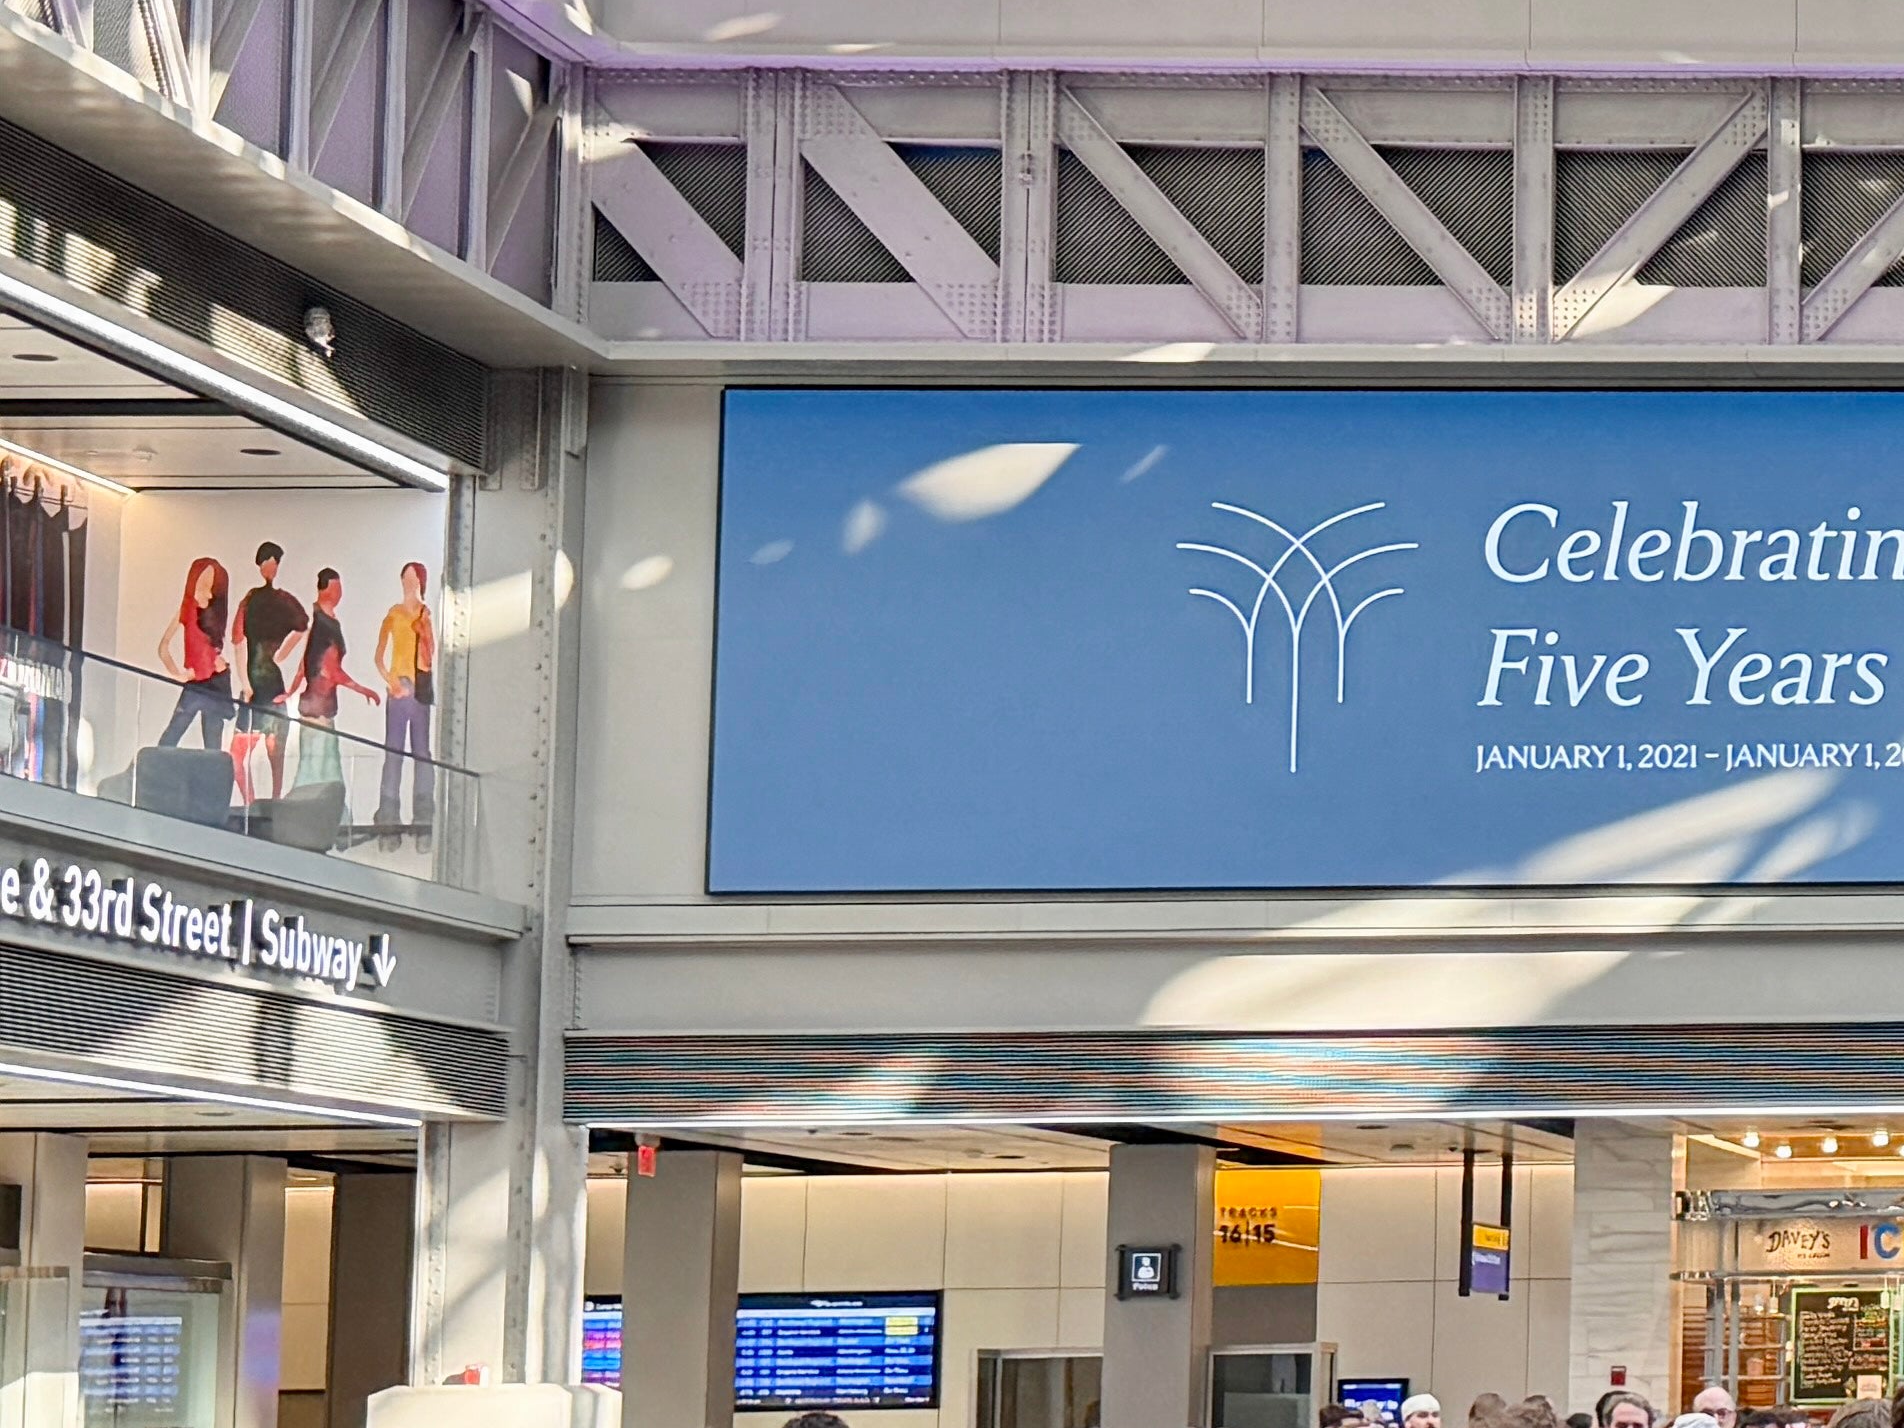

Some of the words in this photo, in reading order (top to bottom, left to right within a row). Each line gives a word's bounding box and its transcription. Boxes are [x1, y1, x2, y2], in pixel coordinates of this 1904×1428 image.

[1476, 628, 1651, 708] Five
[1675, 627, 1889, 707] Years
[1476, 744, 1611, 772] JANUARY
[1638, 743, 1697, 769] 2021
[1725, 743, 1861, 771] JANUARY
[28, 857, 55, 921] &
[63, 865, 135, 938] 33rd
[141, 882, 233, 958] Street
[261, 908, 363, 991] Subway
